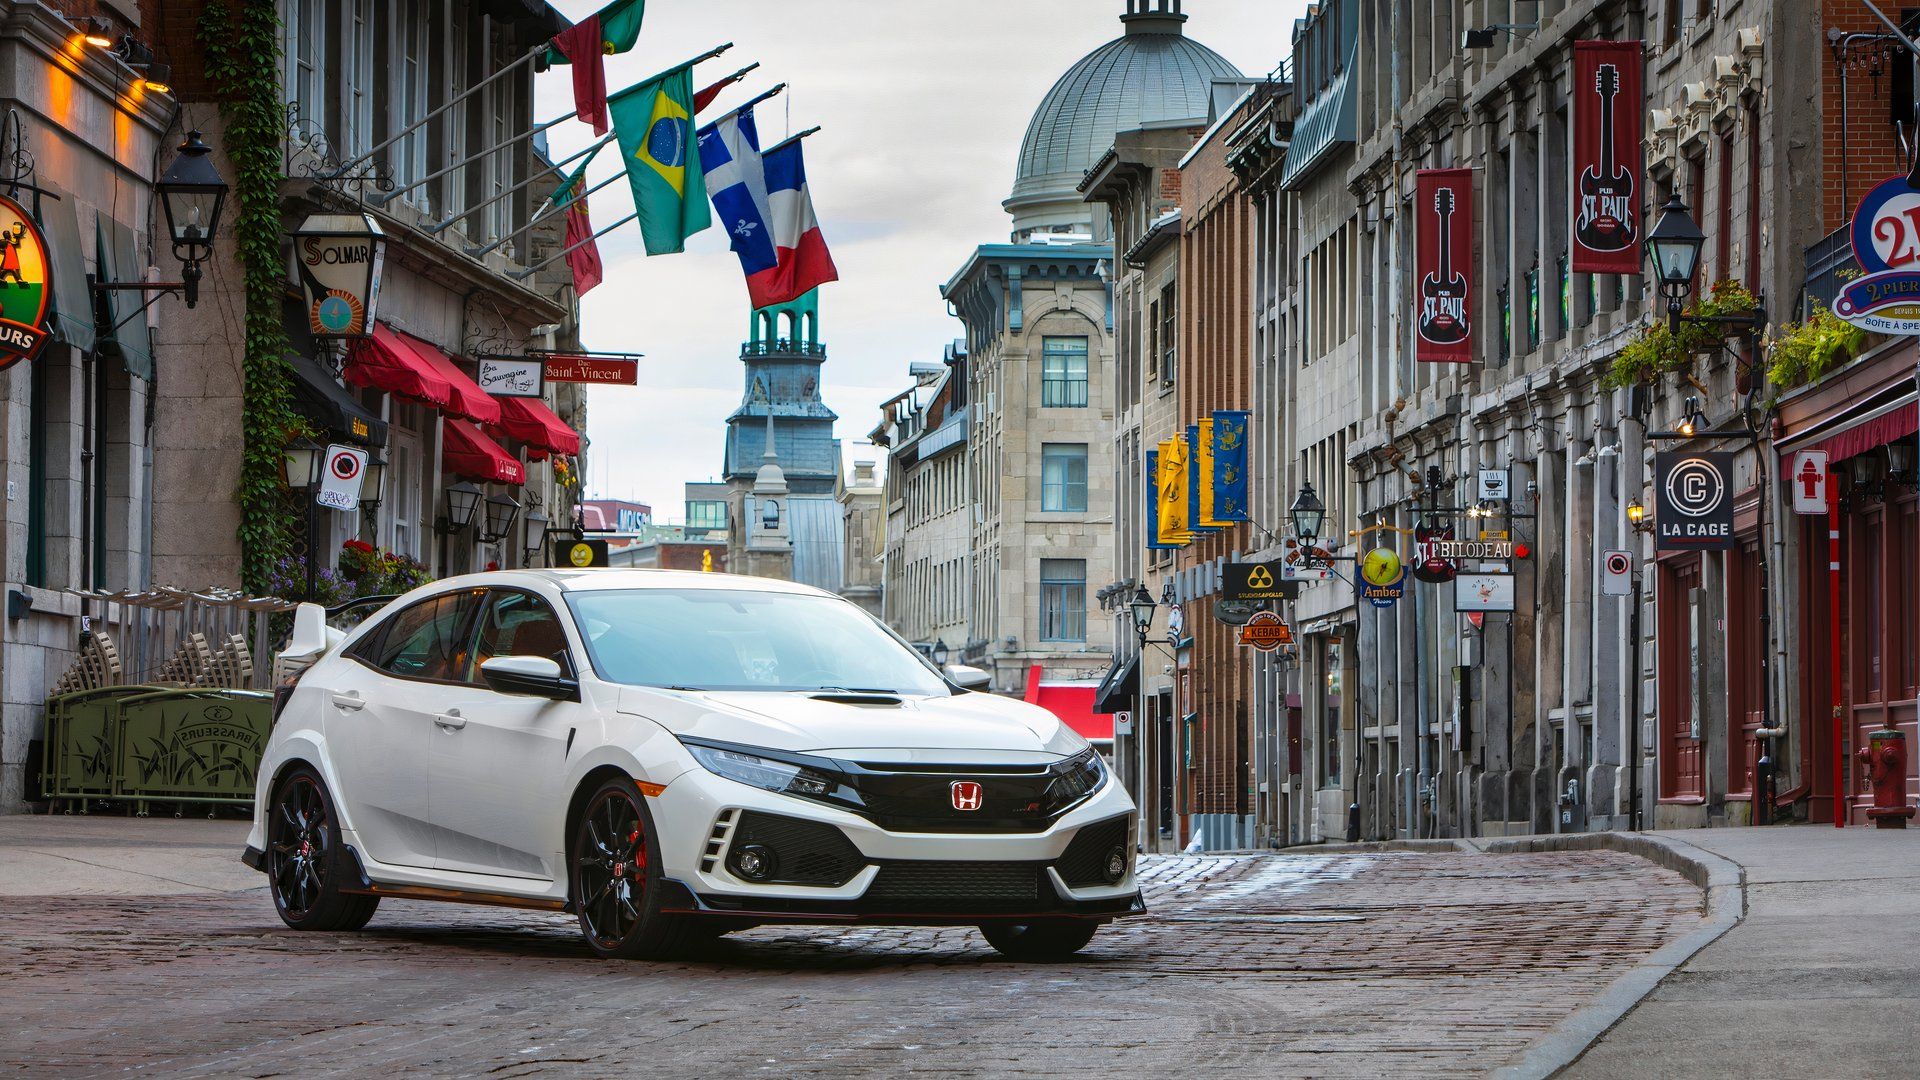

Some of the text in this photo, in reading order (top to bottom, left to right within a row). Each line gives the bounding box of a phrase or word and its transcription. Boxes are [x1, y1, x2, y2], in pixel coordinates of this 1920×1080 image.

[1581, 194, 1631, 234] ST. PAUL
[303, 236, 370, 266] SOLMAR
[1423, 296, 1466, 328] ST. PAUL
[577, 359, 591, 367] Rue
[481, 369, 527, 386] Sauvagine
[545, 365, 623, 380] Saint-Vincent
[1662, 523, 1729, 536] LA CAGE
[1440, 541, 1512, 558] BILODEAU
[1364, 585, 1401, 597] Amber
[1251, 627, 1280, 638] KEBAB
